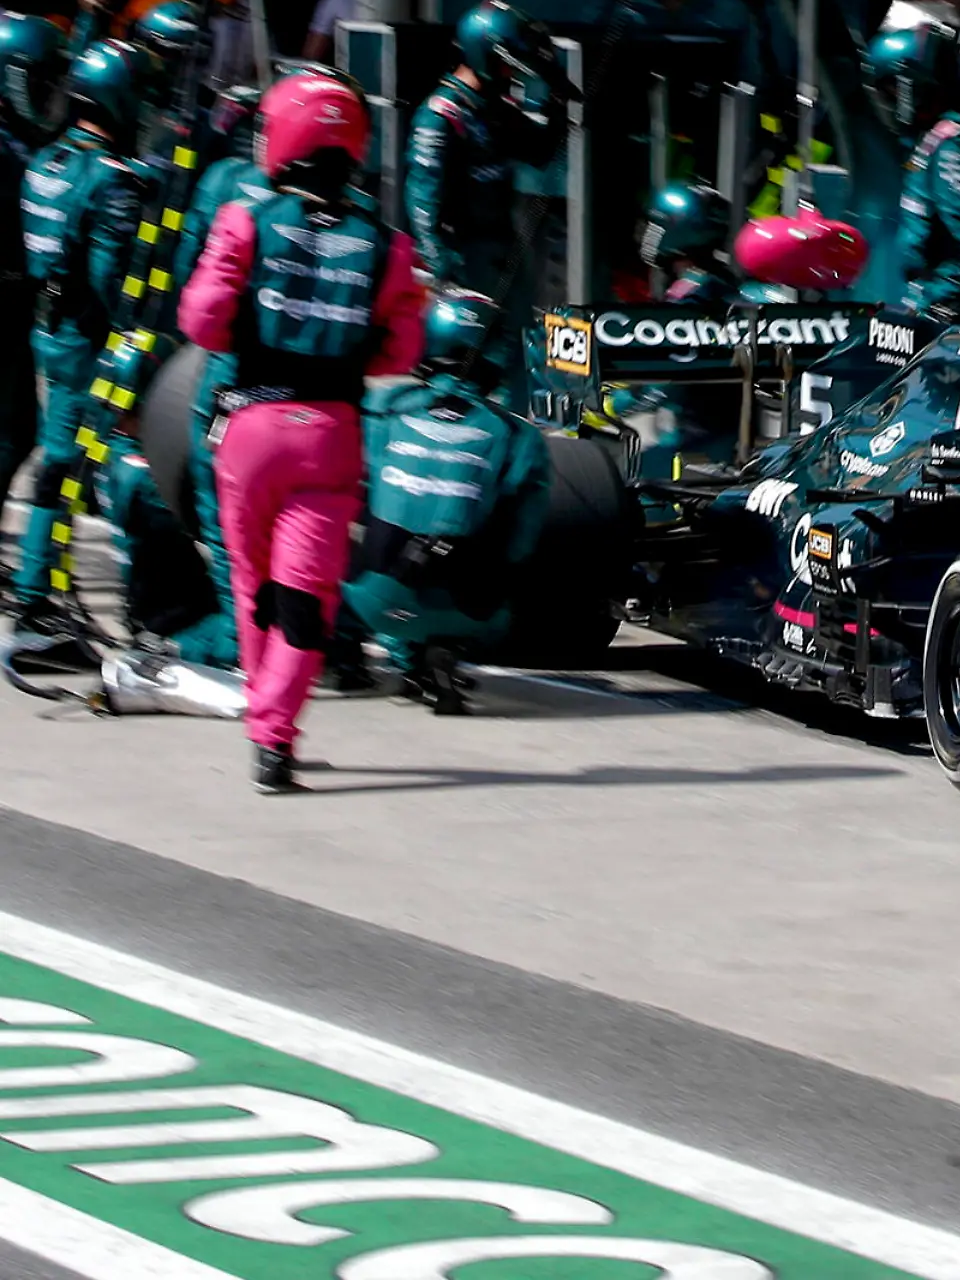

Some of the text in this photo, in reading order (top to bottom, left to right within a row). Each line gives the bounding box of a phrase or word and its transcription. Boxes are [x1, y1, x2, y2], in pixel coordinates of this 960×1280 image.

[549, 325, 587, 364] JCB
[594, 310, 850, 363] Cognizant
[867, 317, 914, 355] PERONI
[800, 372, 833, 436] 5
[810, 533, 831, 554] JCB
